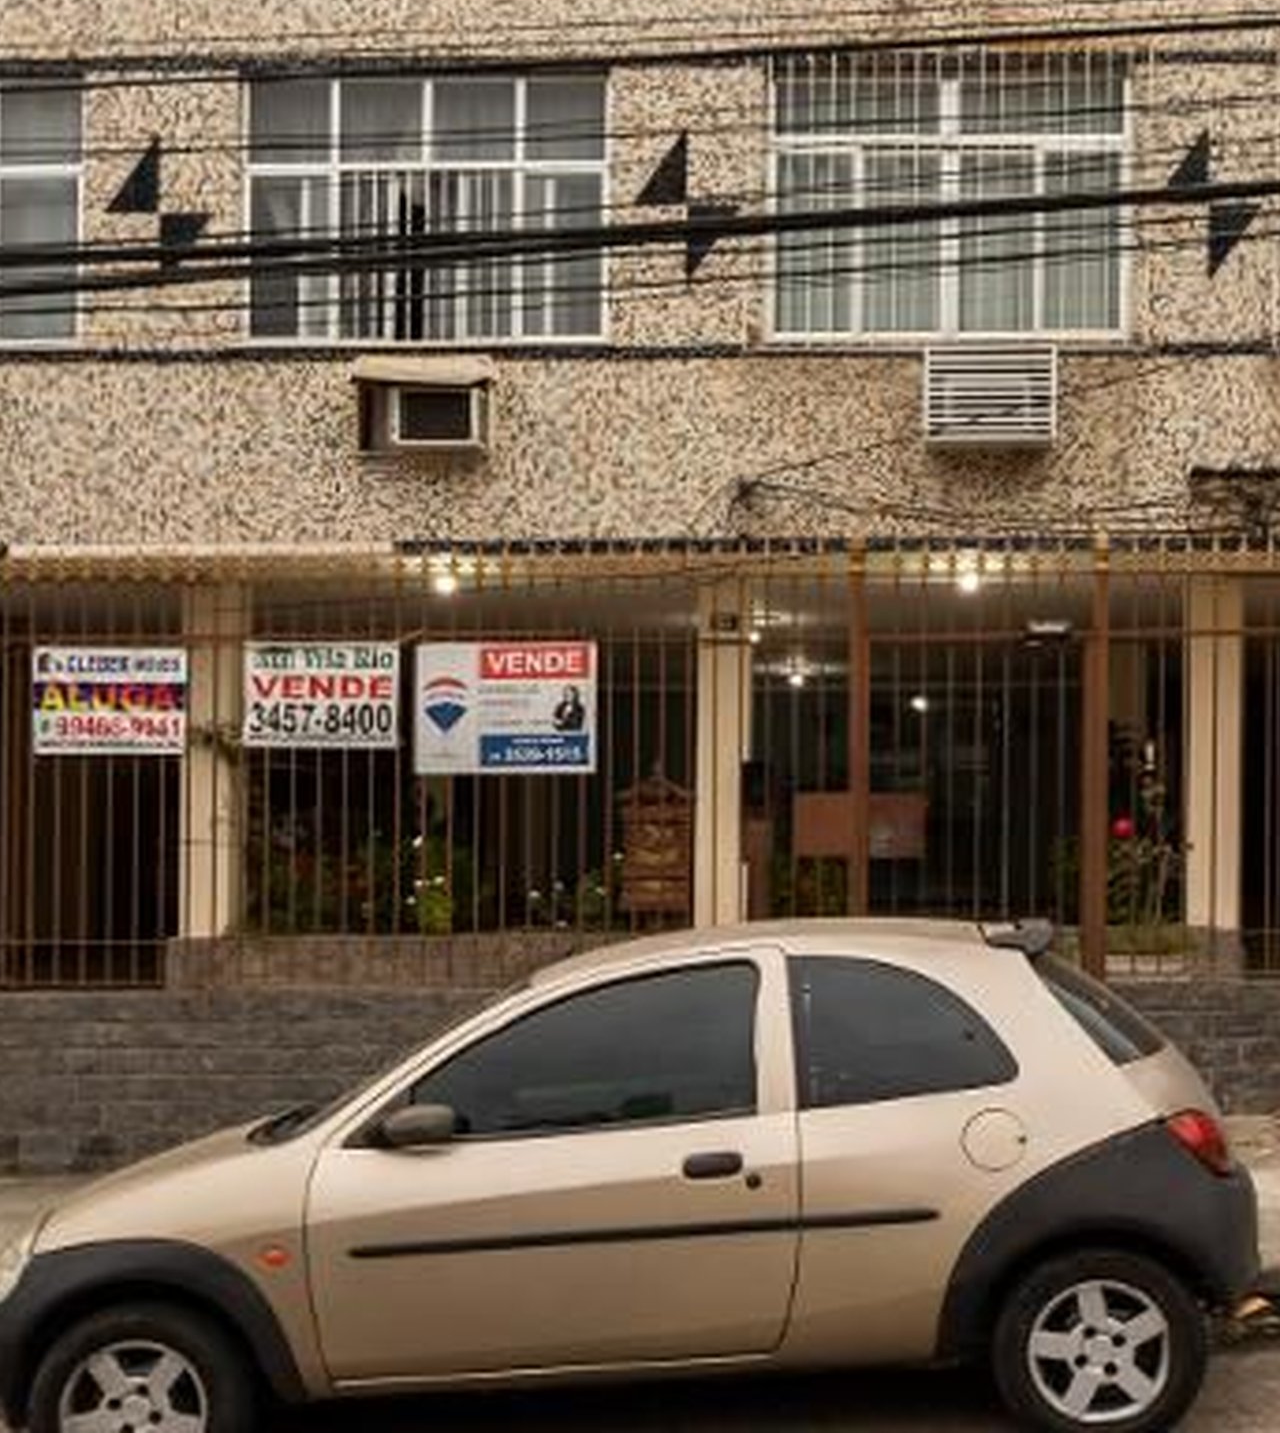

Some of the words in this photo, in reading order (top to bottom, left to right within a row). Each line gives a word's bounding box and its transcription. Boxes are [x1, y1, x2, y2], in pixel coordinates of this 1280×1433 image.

[486, 649, 584, 674] VENDE
[40, 680, 179, 712] ALUGA
[252, 674, 393, 700] VENDE
[249, 702, 393, 735] 3457-8400
